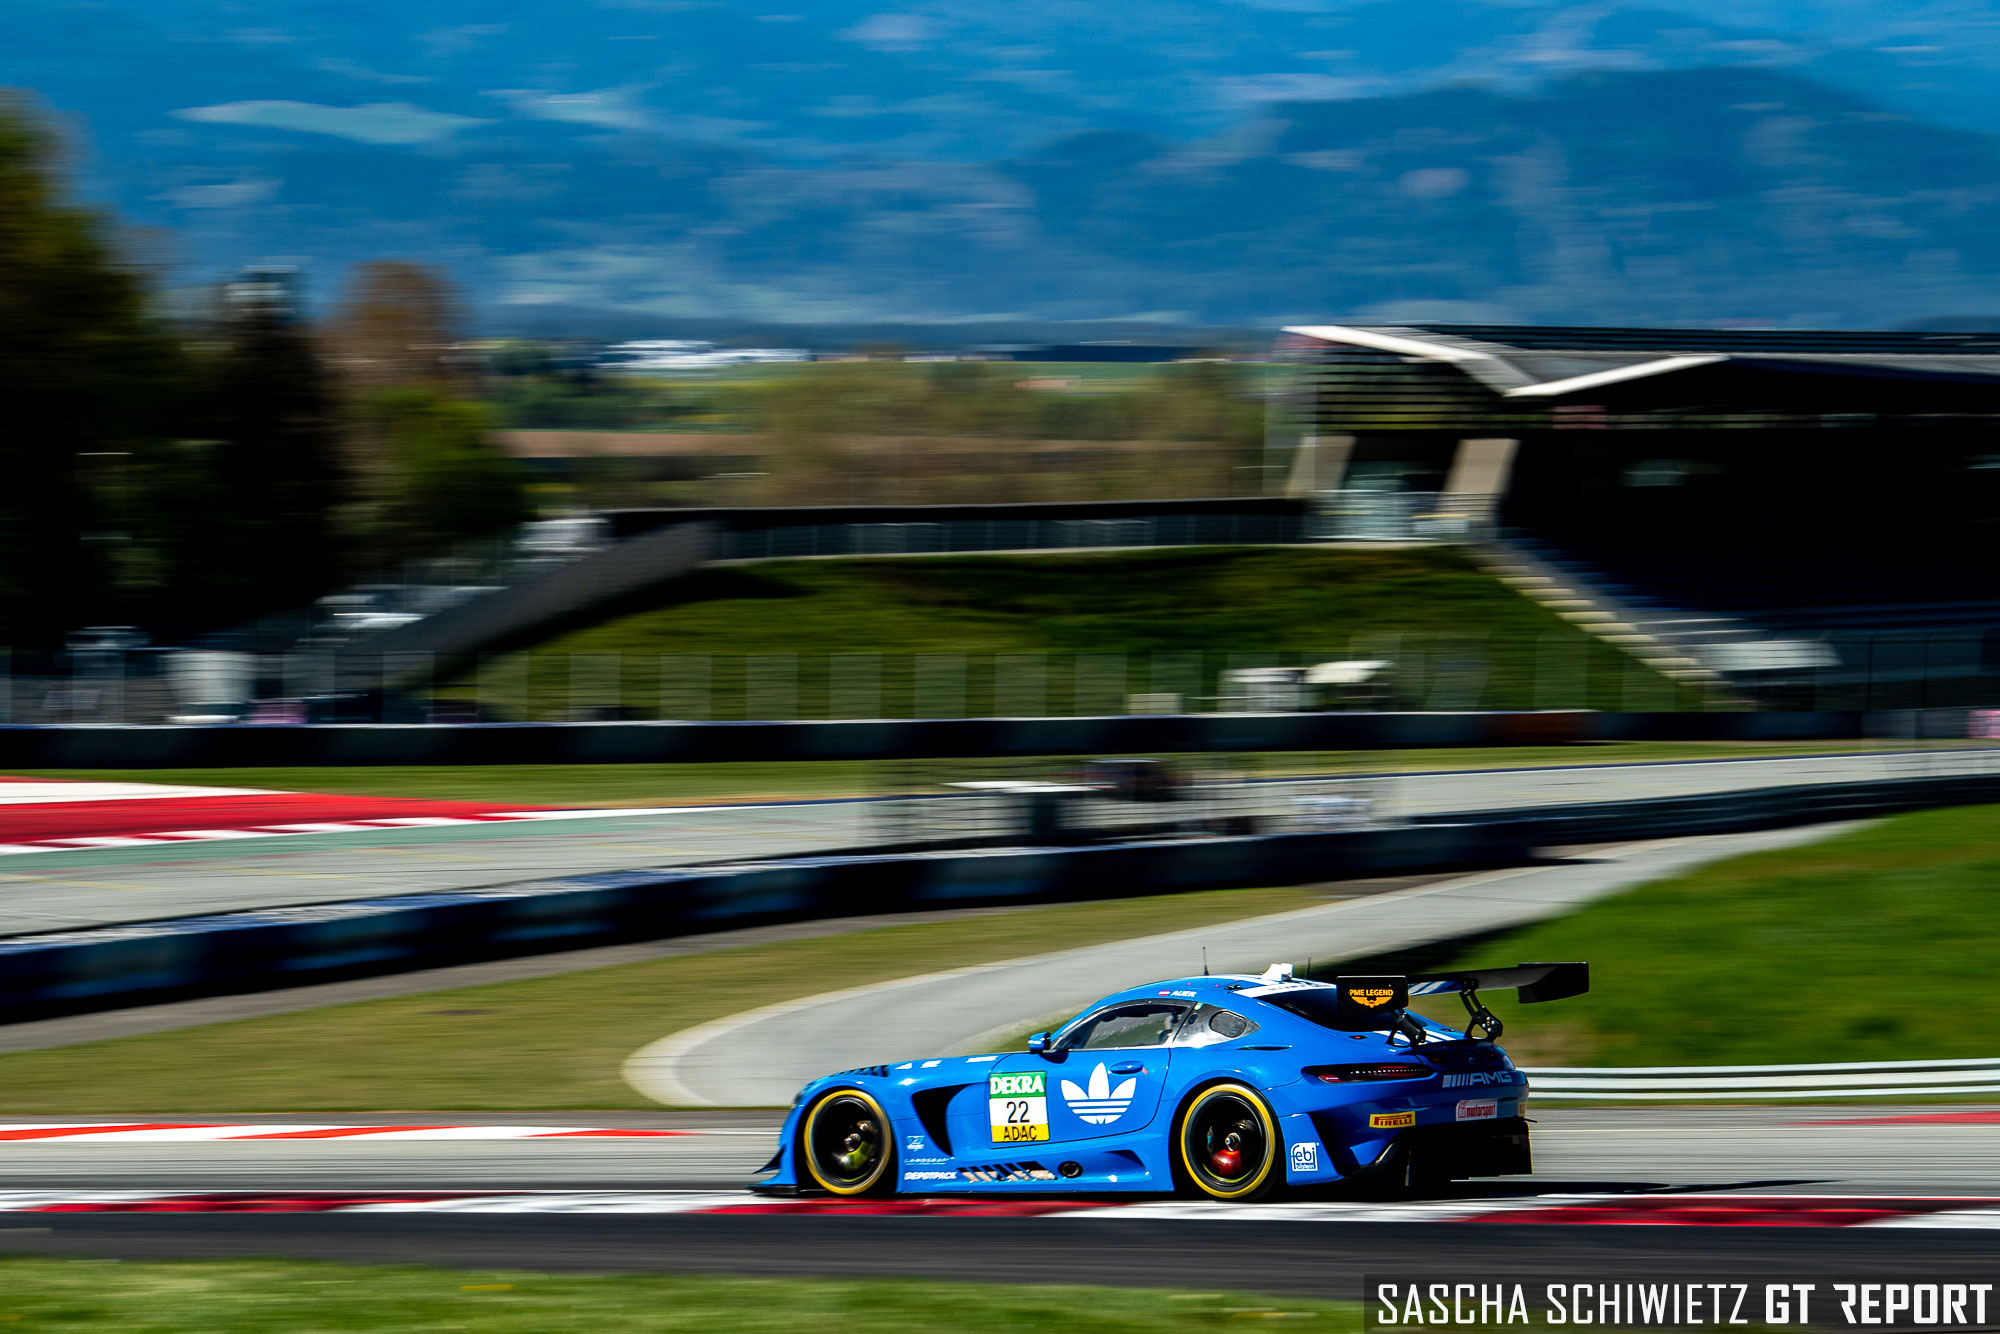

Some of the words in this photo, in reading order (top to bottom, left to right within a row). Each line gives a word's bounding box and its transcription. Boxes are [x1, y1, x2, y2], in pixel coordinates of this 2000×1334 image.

[990, 1075, 1045, 1094] DEKRA
[1469, 1071, 1513, 1085] AMG
[1006, 1101, 1030, 1123] 22
[1466, 1104, 1496, 1118] motorsport
[1374, 1114, 1412, 1126] PIRELLI
[1003, 1125, 1037, 1141] ADAC
[1291, 1144, 1316, 1169] febi
